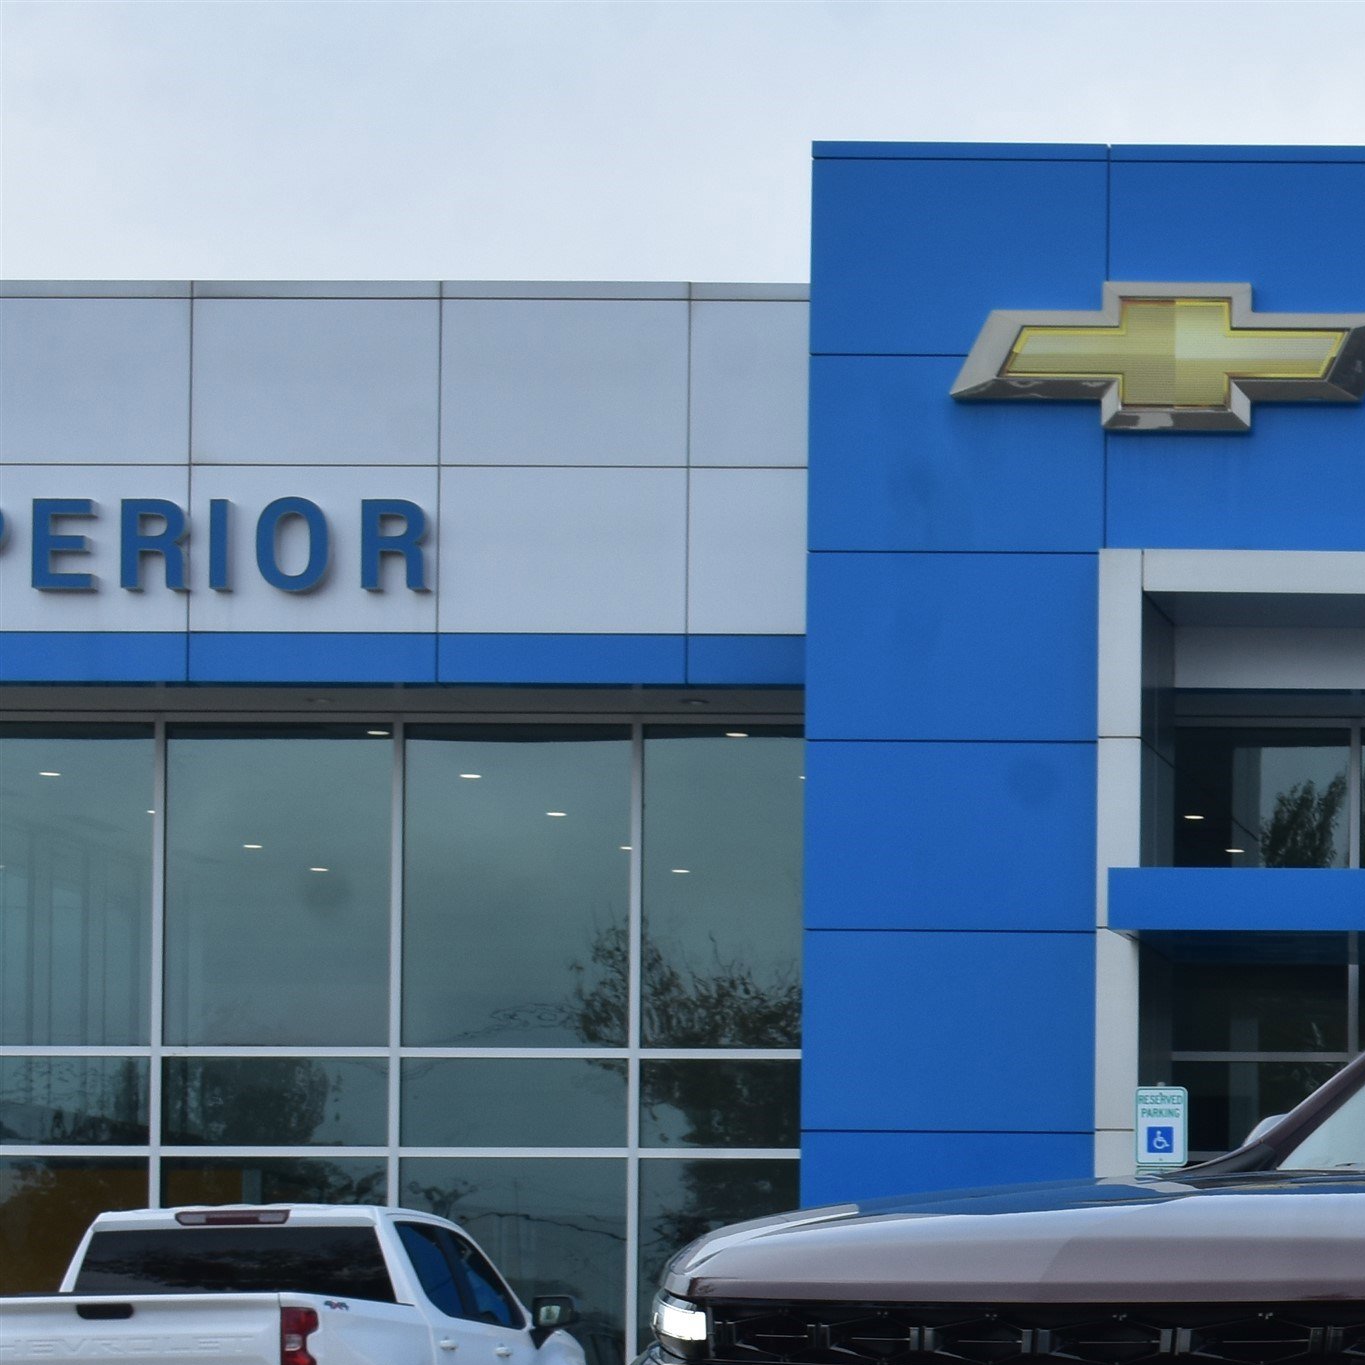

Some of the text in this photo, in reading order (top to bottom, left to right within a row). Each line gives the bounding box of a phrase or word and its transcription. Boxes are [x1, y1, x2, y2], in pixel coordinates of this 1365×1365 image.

[0, 497, 432, 592] ERIOR
[1138, 1094, 1182, 1105] RESERVED
[1140, 1107, 1181, 1118] PARKING
